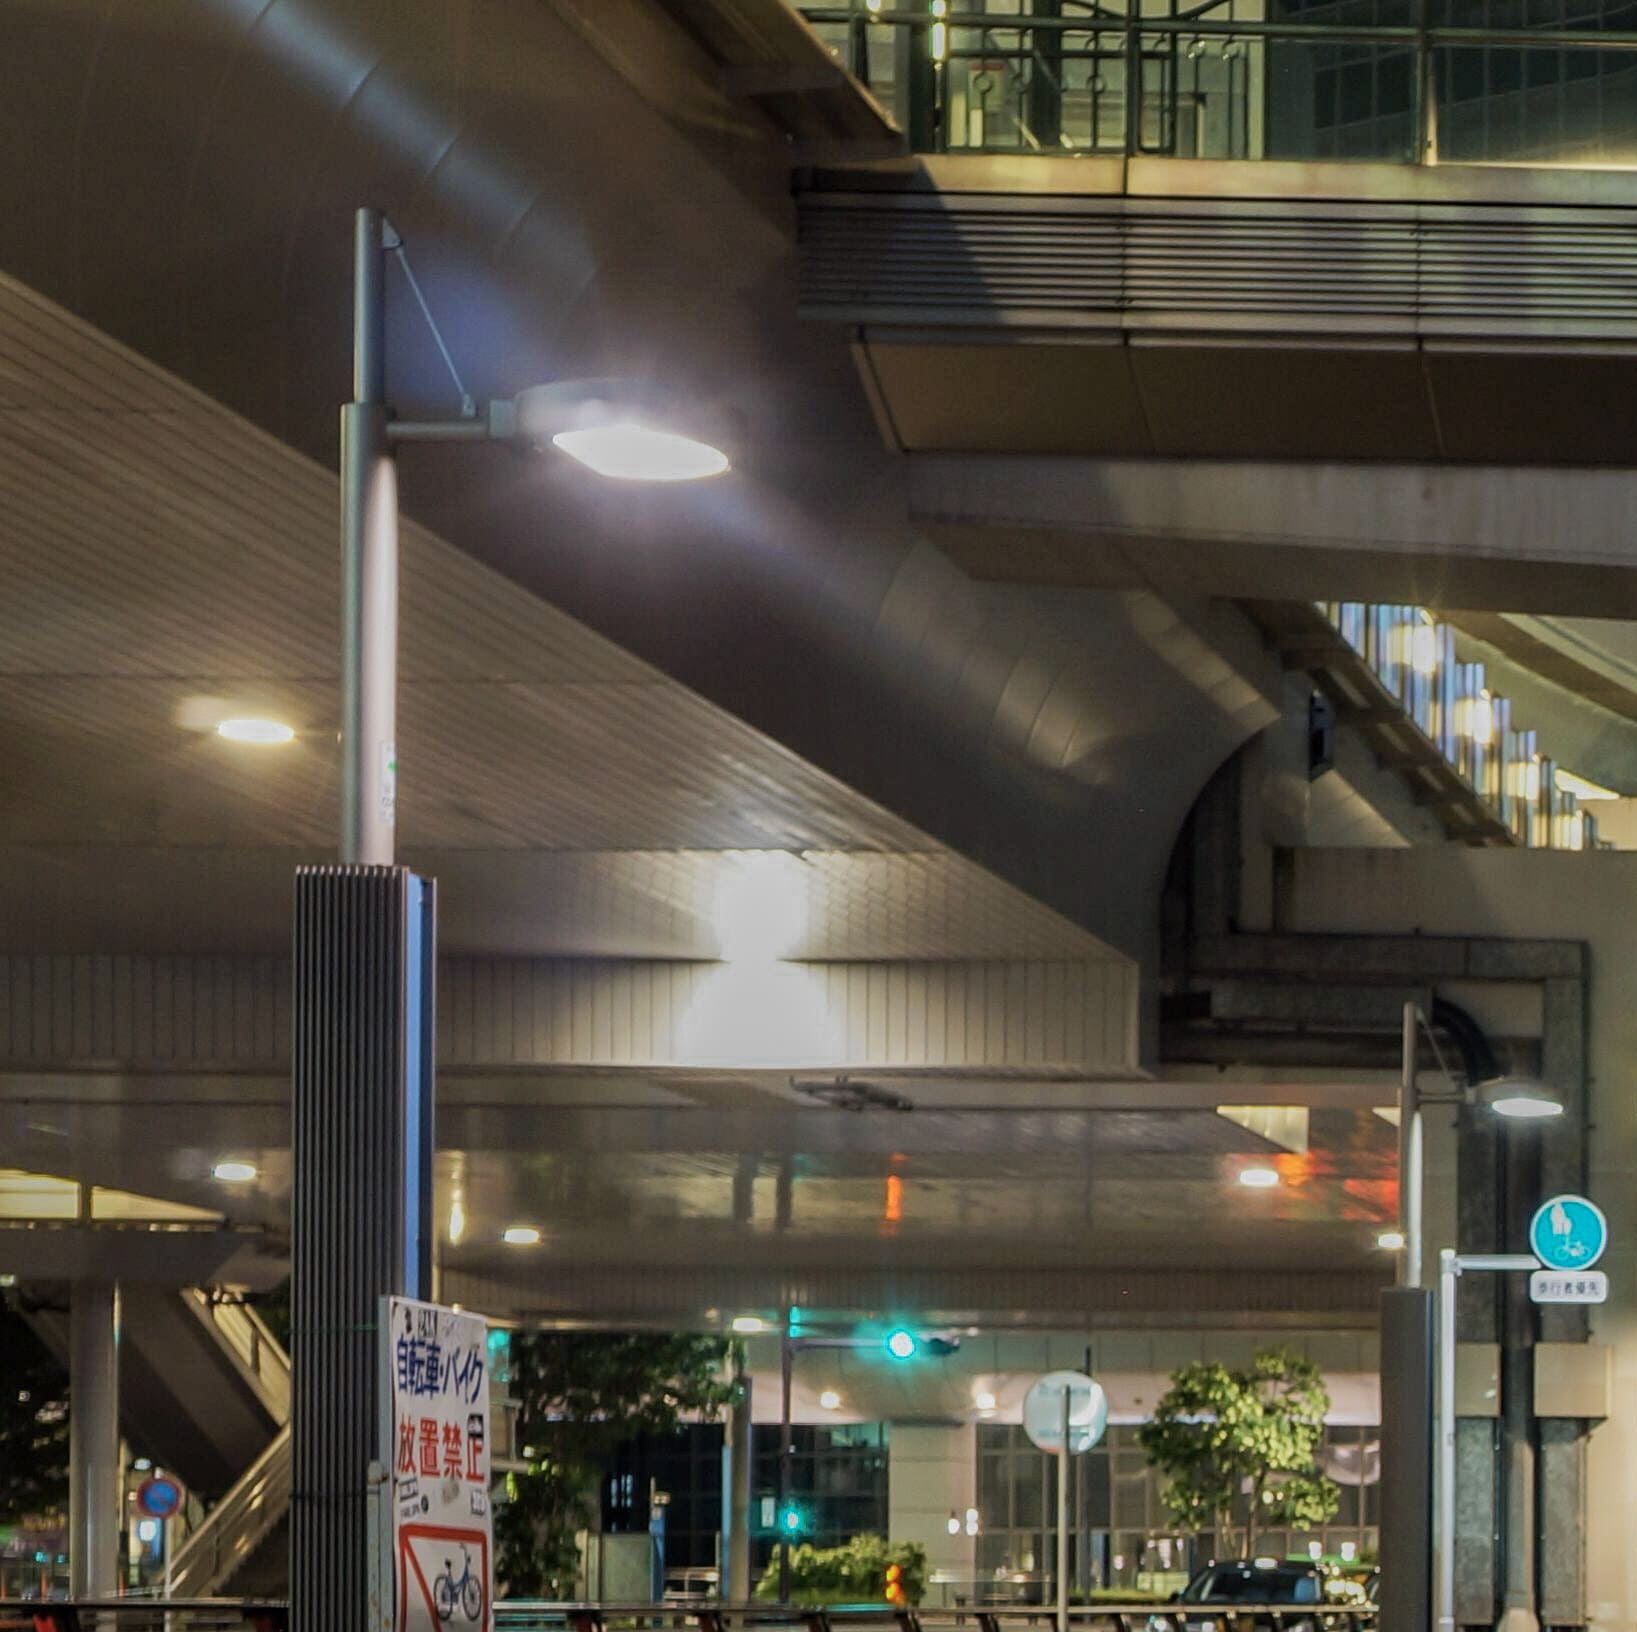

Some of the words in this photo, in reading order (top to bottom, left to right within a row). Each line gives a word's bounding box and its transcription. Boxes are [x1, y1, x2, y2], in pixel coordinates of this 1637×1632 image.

[1537, 1280, 1601, 1296] 歩行者優先
[397, 1334, 484, 1404] 自転車・バイク
[398, 1411, 486, 1482] 放置禁止
